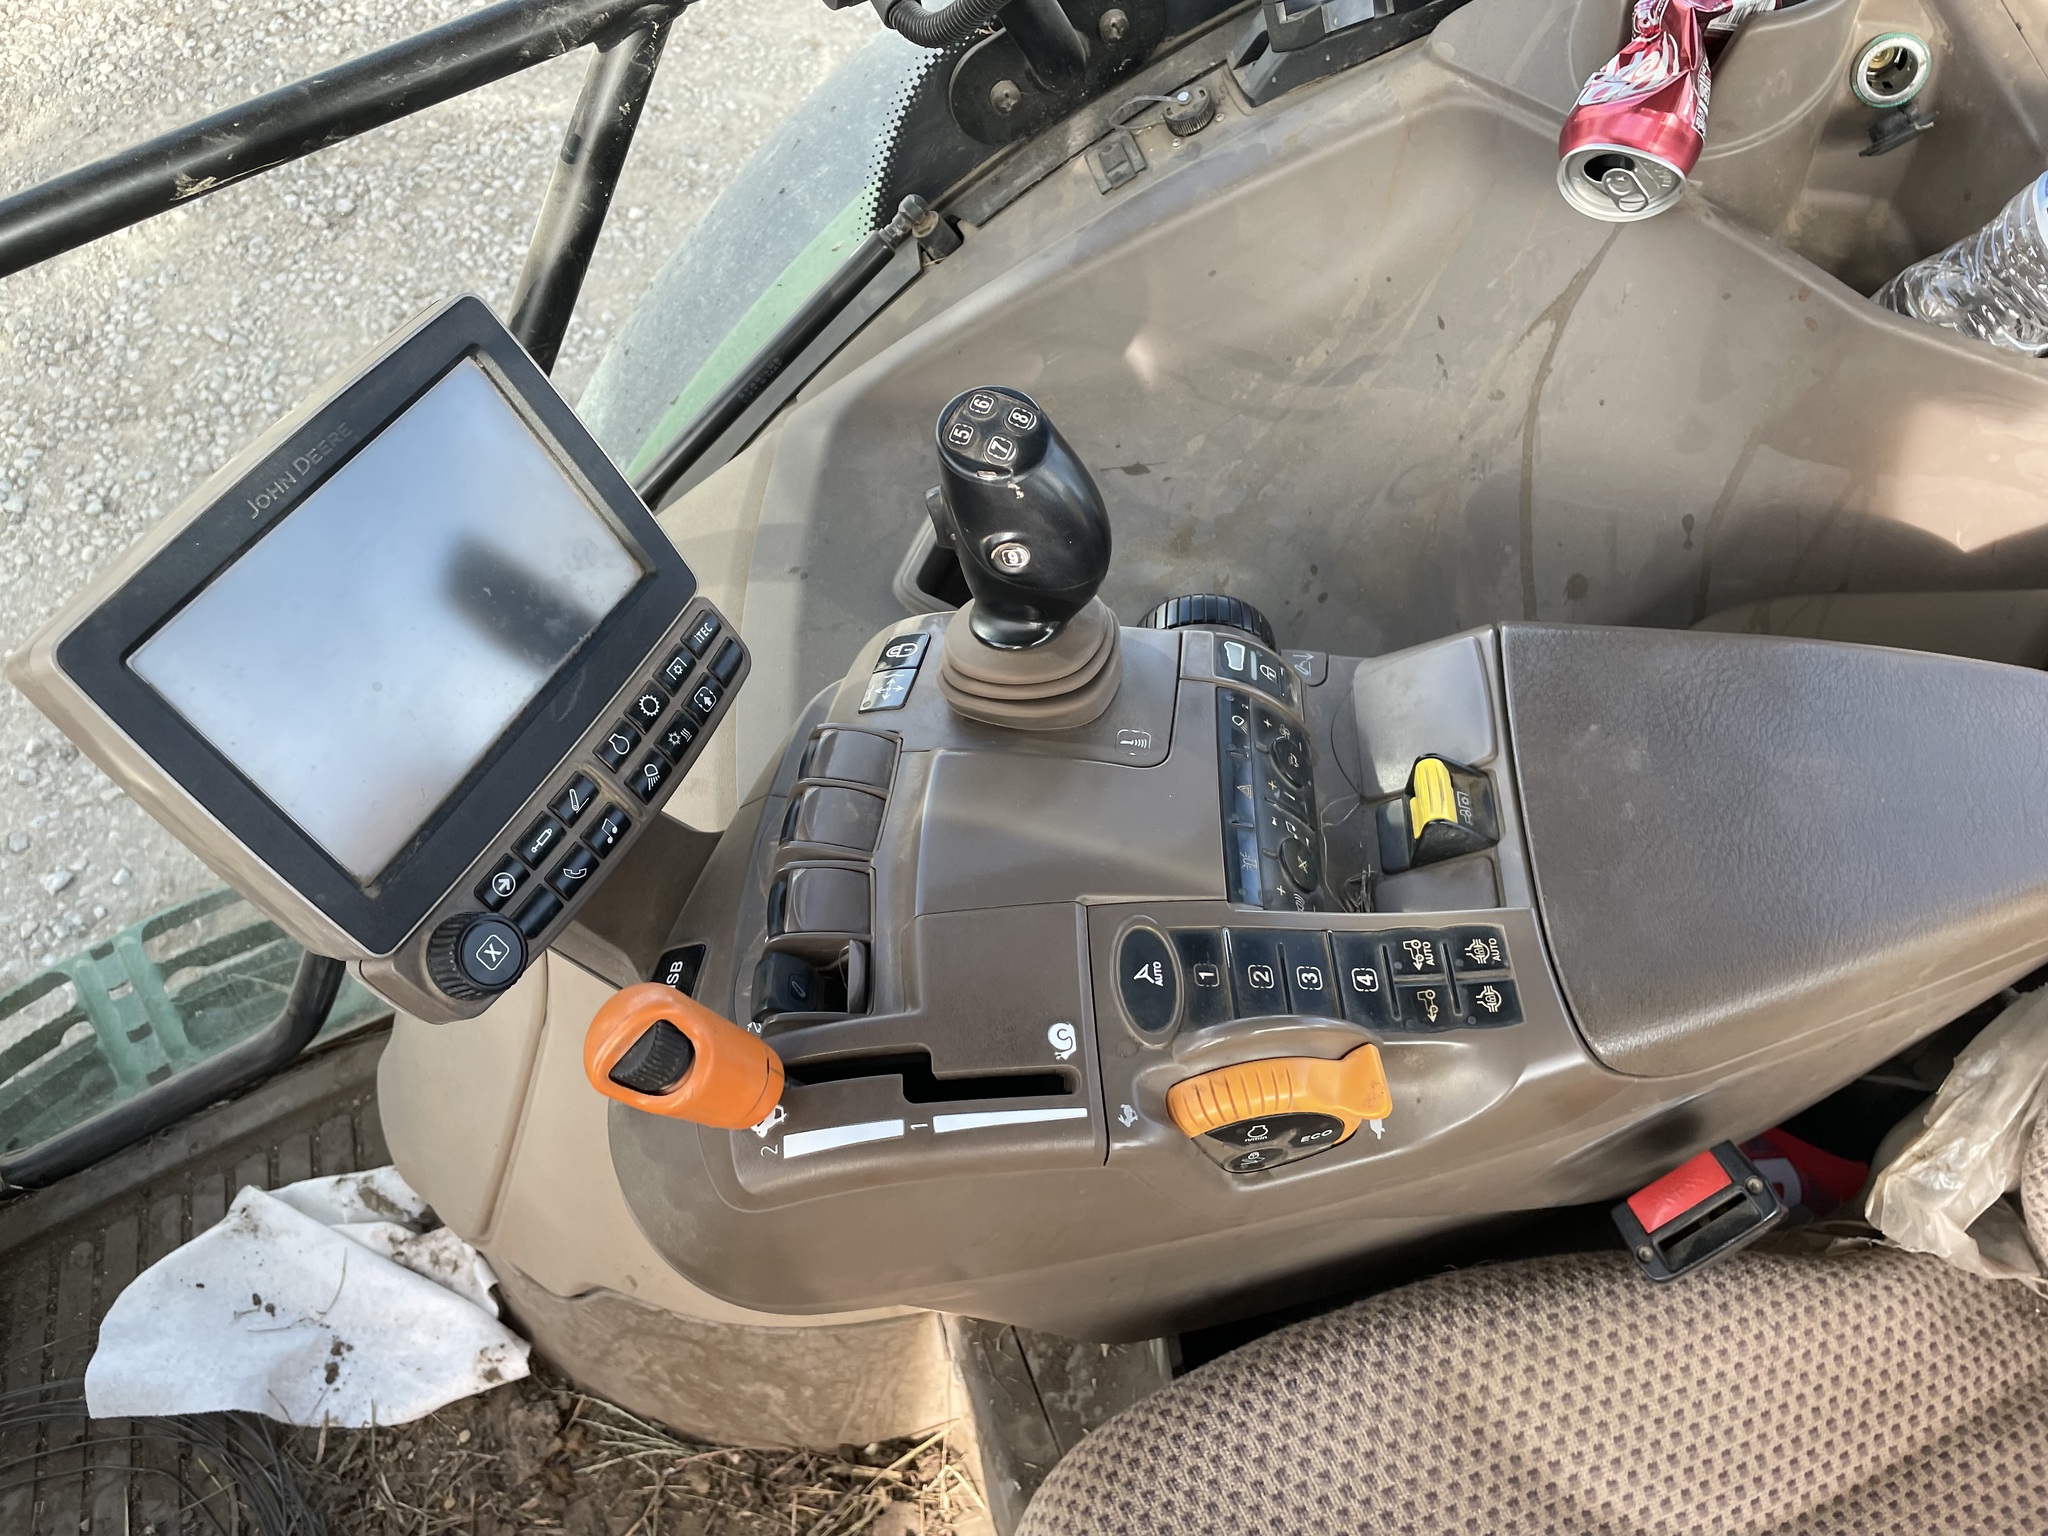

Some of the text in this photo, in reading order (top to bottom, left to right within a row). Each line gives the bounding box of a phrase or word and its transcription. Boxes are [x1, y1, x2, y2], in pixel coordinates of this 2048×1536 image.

[973, 398, 990, 409] 6
[1012, 411, 1029, 424] 8
[953, 428, 970, 440] 5
[990, 440, 1008, 453] 7
[246, 421, 353, 520] JOHN DEERE
[693, 622, 713, 644] iTEC
[1422, 941, 1435, 966] AUTO
[1488, 938, 1502, 962] AUTO
[666, 961, 683, 989] SB
[1152, 960, 1164, 987] AUTO
[1198, 971, 1214, 980] 1
[1253, 971, 1270, 983] 2
[1301, 972, 1318, 984] 3
[1356, 974, 1374, 986] 4
[910, 1122, 929, 1131] 1
[1300, 1129, 1333, 1143] ECO
[760, 1144, 778, 1156] 2
